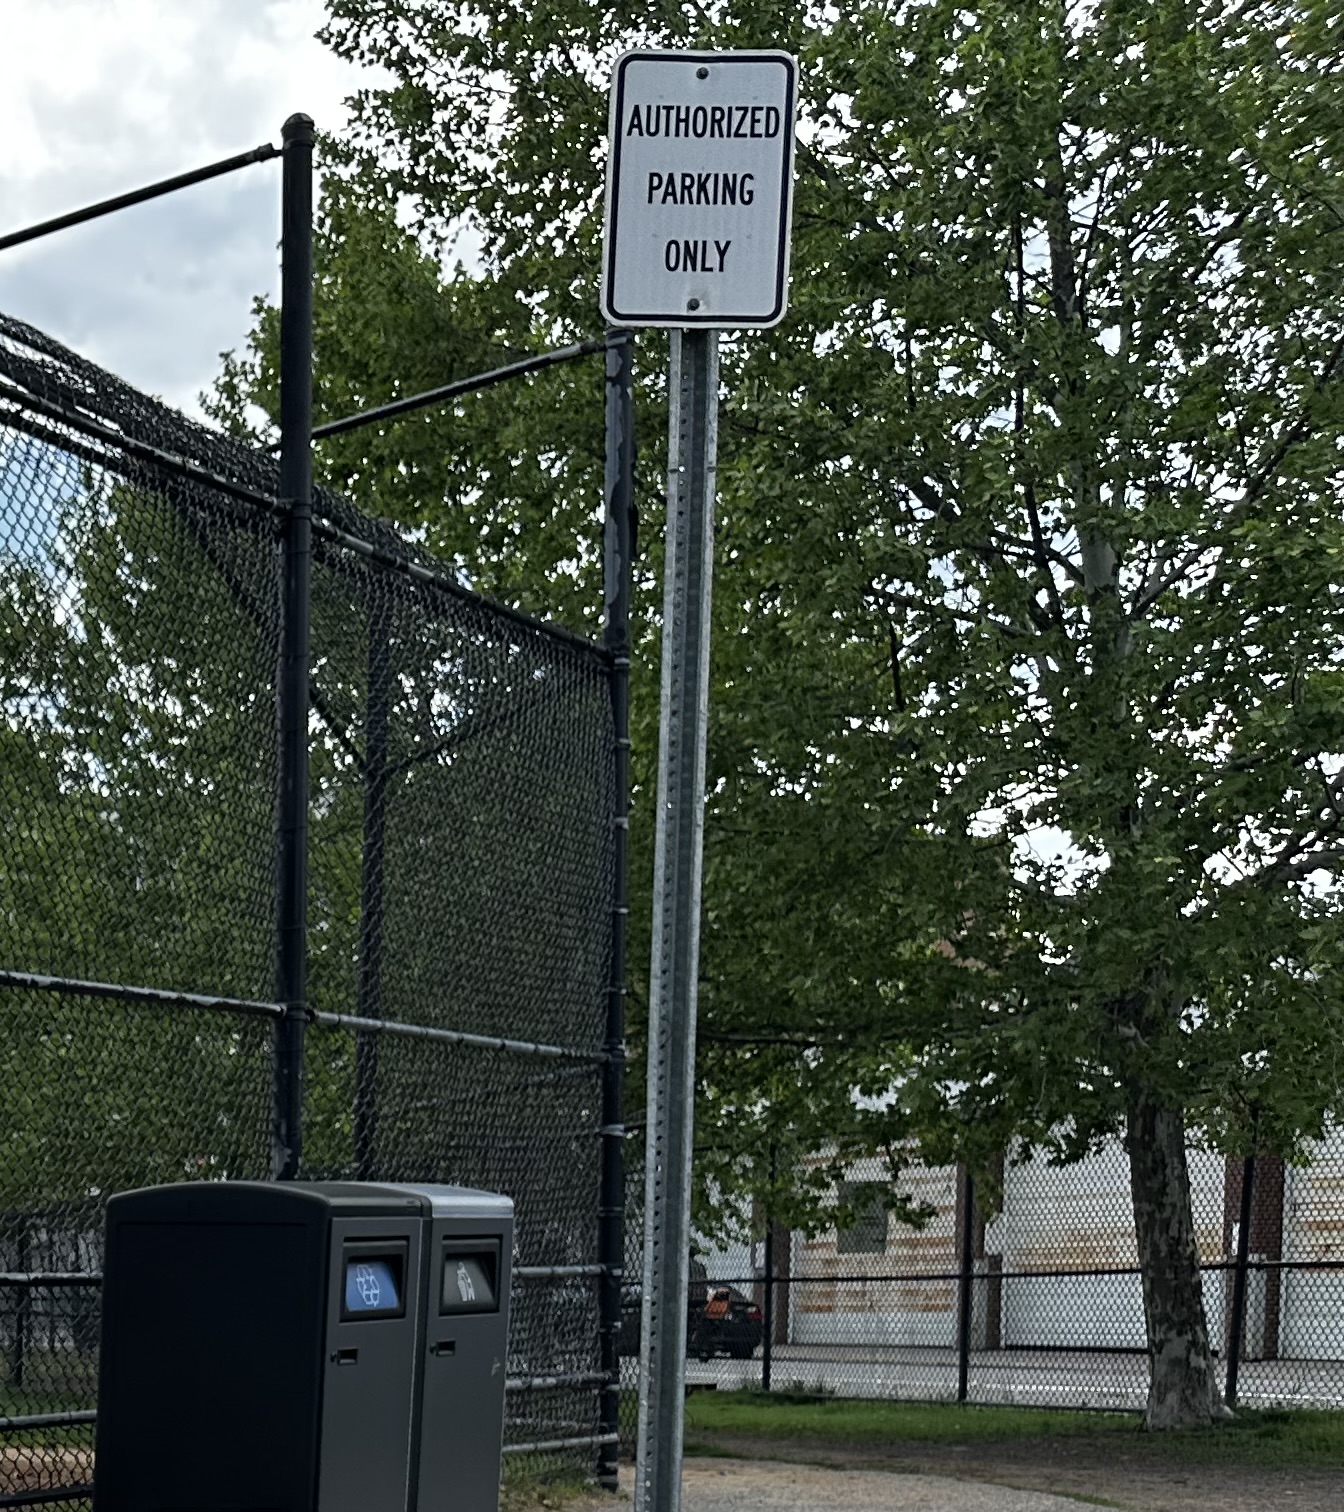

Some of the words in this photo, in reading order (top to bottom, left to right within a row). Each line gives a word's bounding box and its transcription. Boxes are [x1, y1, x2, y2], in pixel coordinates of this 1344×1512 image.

[627, 105, 780, 138] AUTHORIZED
[648, 173, 755, 205] PARKING
[665, 240, 731, 272] ONLY
